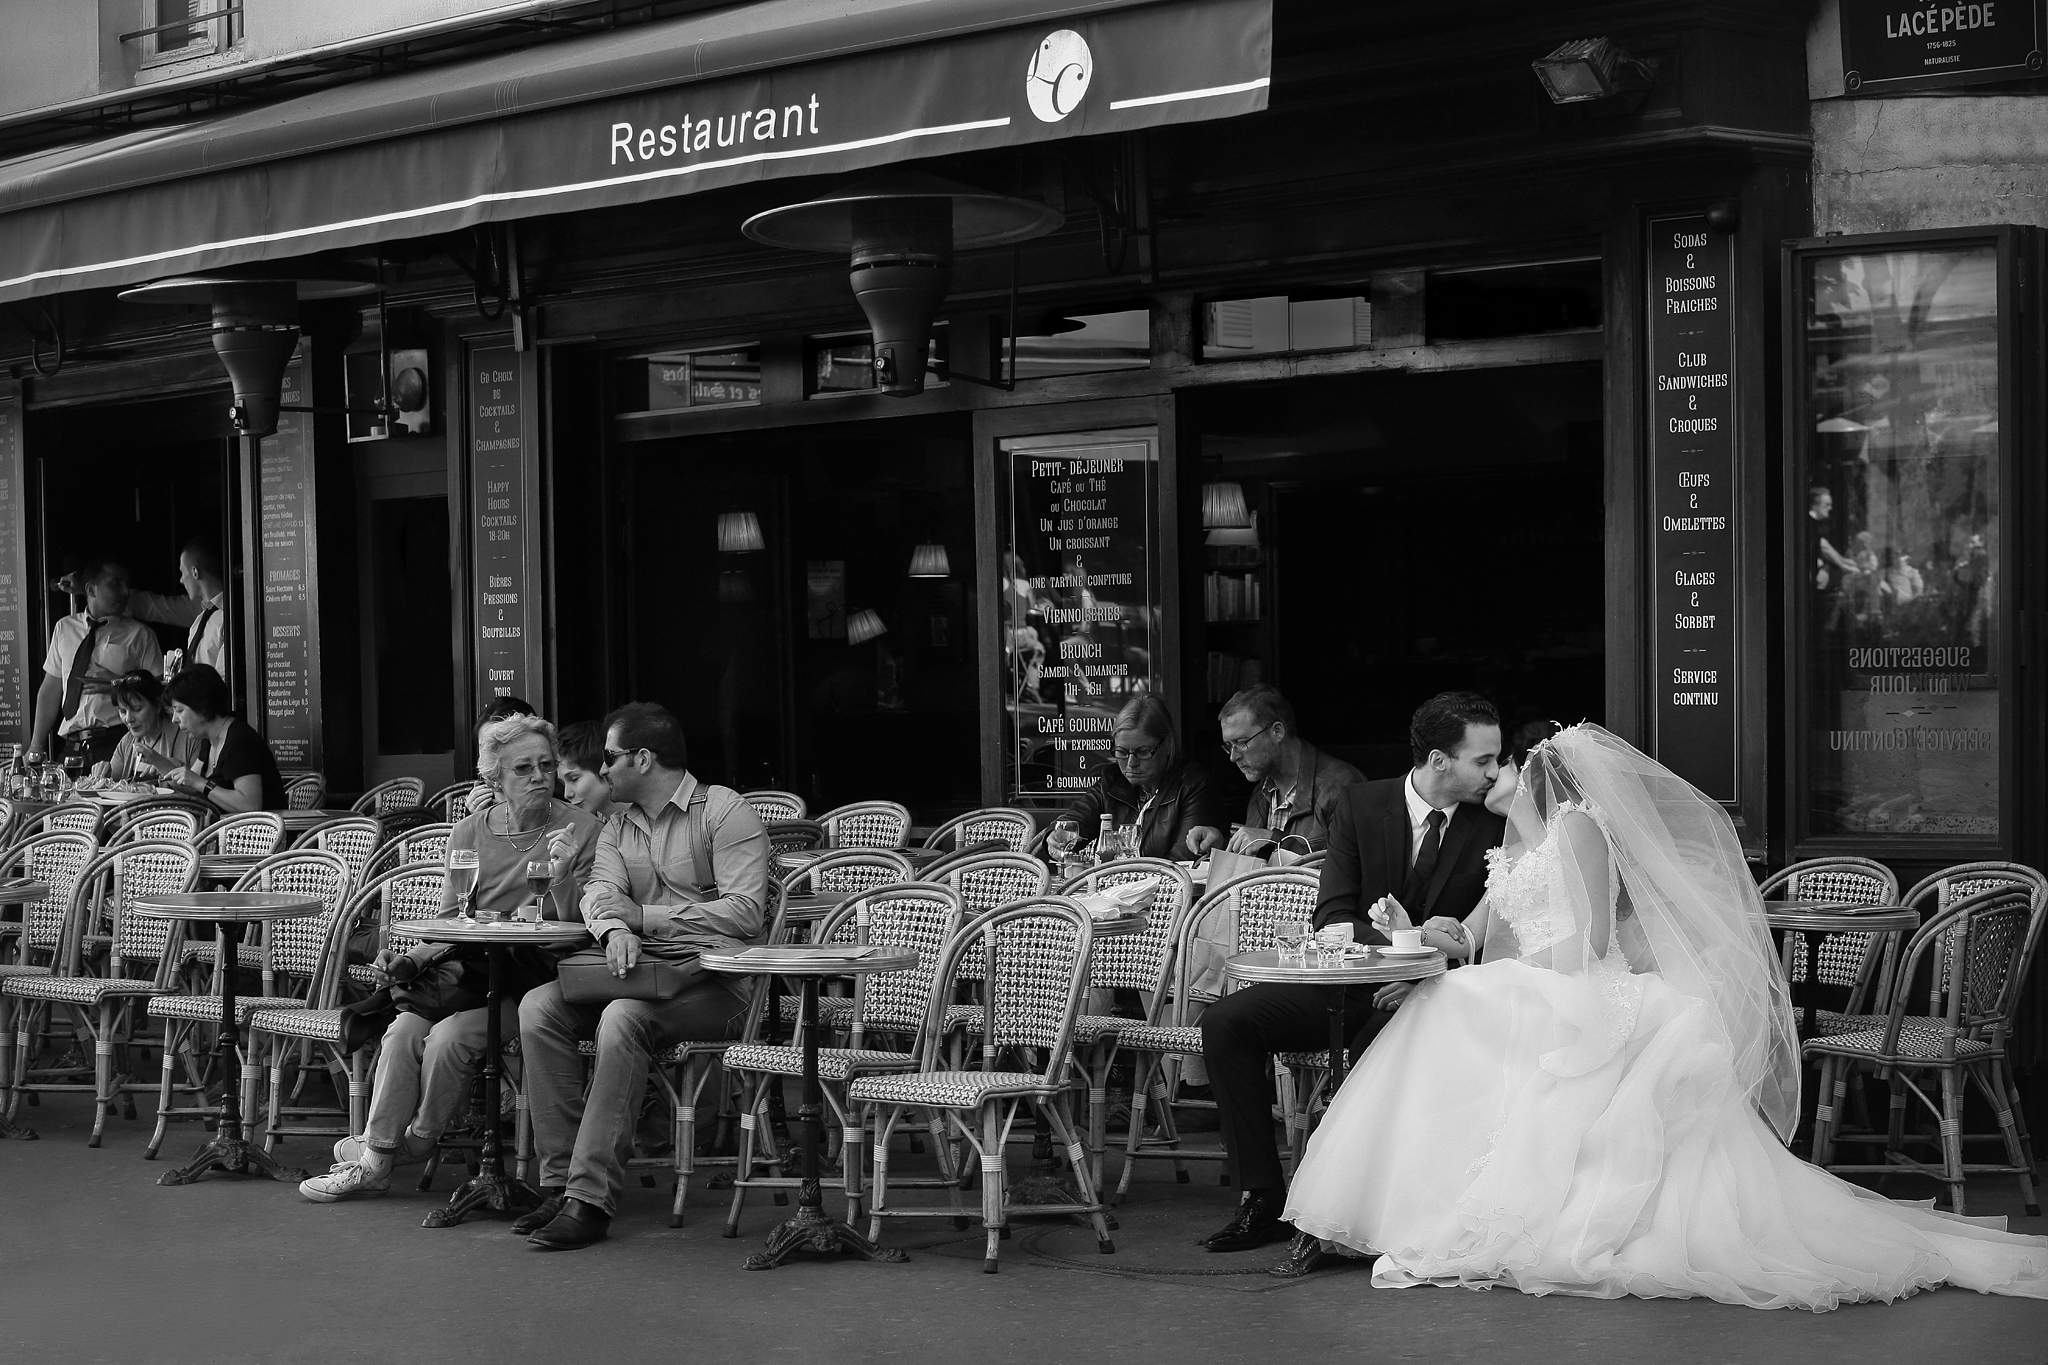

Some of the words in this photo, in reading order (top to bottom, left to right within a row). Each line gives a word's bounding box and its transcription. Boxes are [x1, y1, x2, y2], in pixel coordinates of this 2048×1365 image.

[1886, 1, 1996, 38] LACÉPÈDE
[1927, 40, 1956, 49] 1756-1825
[1925, 55, 1960, 66] NATURALISTE
[612, 92, 819, 165] Restaurant
[1674, 233, 1707, 248] SODAS
[1686, 254, 1695, 269] &
[1666, 276, 1715, 293] BOISSONS
[1666, 298, 1717, 314] FRAICHES
[1678, 352, 1706, 367] CLUB
[493, 371, 513, 382] CHOIX
[1659, 374, 1728, 390] SANDWICHES
[493, 389, 501, 399] DE
[1688, 395, 1697, 410] &
[480, 405, 515, 417] COCKTAILS
[494, 421, 500, 432] &
[1670, 418, 1717, 434] CROQUES
[476, 438, 520, 451] CHAMPAGNES
[1070, 456, 1124, 475] DÉJEUNER
[1051, 479, 1071, 494] CAFÉ
[1076, 483, 1084, 492] OU
[1089, 476, 1106, 492] THÉ
[1679, 472, 1710, 487] ŒUFS
[488, 481, 509, 493] HAPPY
[488, 499, 510, 510] HOURS
[1051, 504, 1059, 513] OU
[1064, 498, 1106, 512] CHOCOLAT
[1690, 493, 1698, 508] &
[481, 515, 516, 527] COCKTAILS
[1040, 518, 1053, 532] UN
[1058, 519, 1074, 531] JUS
[1078, 517, 1118, 530] D'ORANGE
[1663, 516, 1725, 531] OMELETTES
[1049, 537, 1062, 550] UN
[1066, 536, 1110, 549] CROISSANT
[1077, 555, 1082, 568] &
[270, 570, 300, 582] FROMAGES
[490, 574, 512, 587] BIÈRES
[1030, 577, 1045, 589] UNE
[1050, 576, 1083, 587] TARTINE
[1088, 573, 1132, 586] CONFITURE
[1676, 570, 1715, 586] GLACES
[484, 593, 517, 604] PRESSIONS
[1691, 592, 1699, 607] &
[498, 609, 503, 620] &
[1044, 607, 1121, 624] VIENNOISERIES
[1675, 614, 1715, 629] SORBET
[273, 626, 300, 637] DESSERTS
[482, 626, 520, 638] BOUTEILLES
[1060, 644, 1102, 659] BRUNCH
[489, 669, 514, 680] OUVERT
[1038, 665, 1069, 678] SAMEDI
[1074, 664, 1080, 677] &
[1085, 664, 1128, 676] DIMANCHE
[1674, 668, 1716, 684] SERVICE
[494, 687, 511, 697] TOUS
[1673, 692, 1718, 705] CONTINU
[269, 709, 283, 717] Nougat
[1038, 714, 1064, 733] CAFÉ
[1054, 737, 1067, 751] UN
[1072, 738, 1111, 750] EXPRESSO
[1080, 756, 1086, 769] &
[1047, 775, 1053, 788] 3
